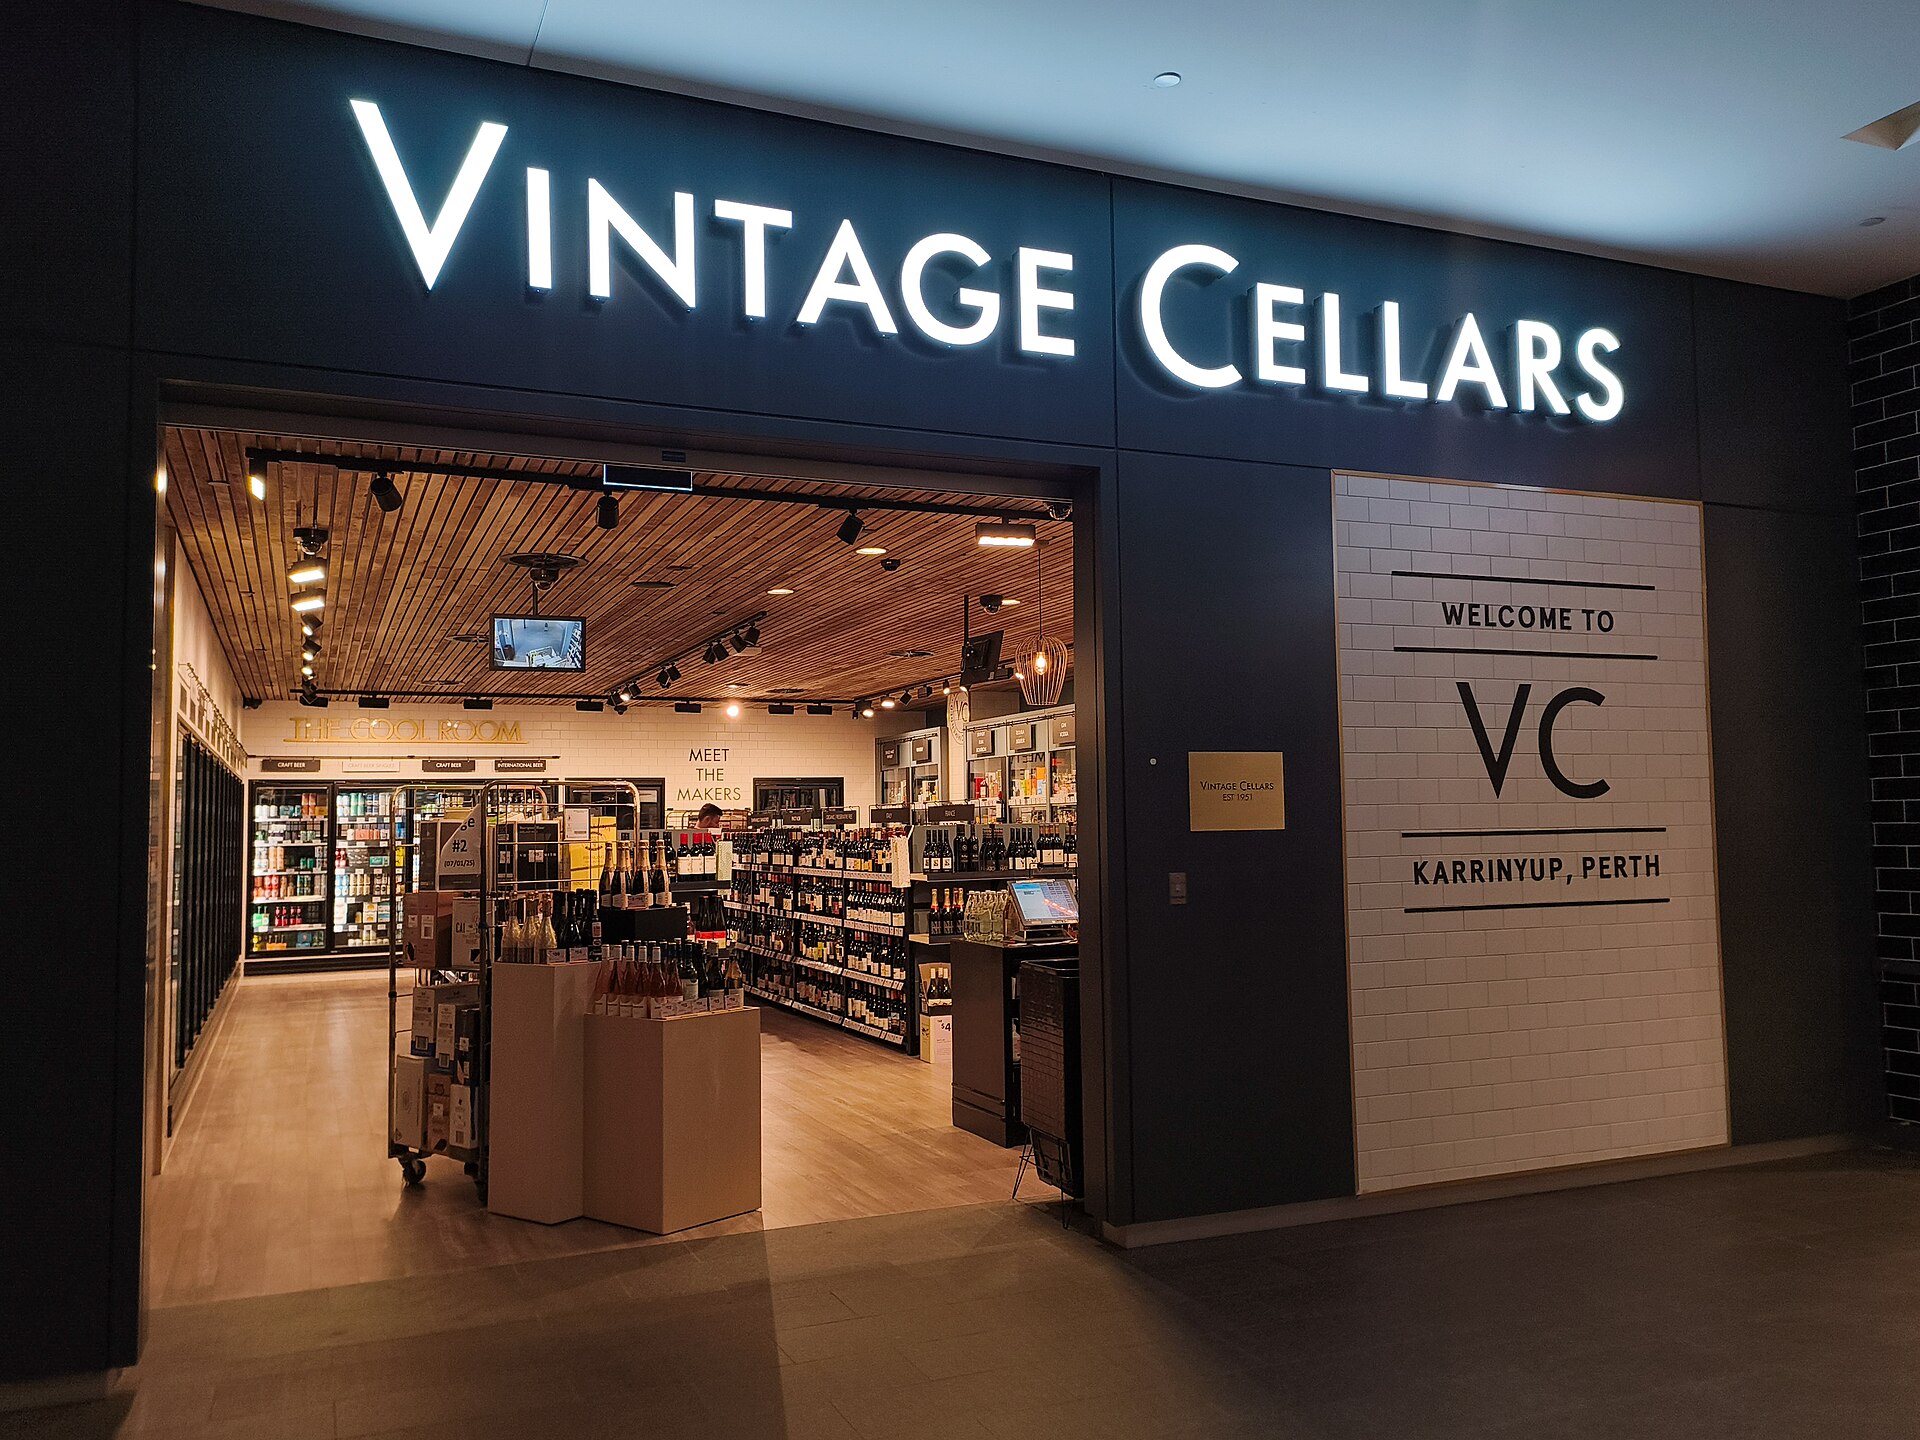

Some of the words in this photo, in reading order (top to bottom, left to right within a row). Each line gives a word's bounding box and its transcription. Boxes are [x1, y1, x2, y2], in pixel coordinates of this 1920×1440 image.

[350, 99, 1076, 357] VINTAGE
[1139, 243, 1625, 422] CELLARS
[1441, 602, 1572, 631] WELCOME
[1581, 609, 1614, 632] TO
[289, 717, 340, 740] THE
[350, 717, 430, 741] COOL
[438, 719, 522, 741] ROOM
[1455, 682, 1611, 799] VC
[689, 748, 730, 762] MEET
[696, 768, 724, 781] THE
[1200, 781, 1237, 791] VINTAGE
[1239, 781, 1275, 791] CELLARS
[677, 787, 741, 801] MAKERS
[1223, 793, 1235, 801] EST
[1237, 793, 1253, 801] 1951
[452, 839, 467, 853] #2
[444, 859, 475, 868] (07/01/25)
[1413, 857, 1573, 885] KARRINYUP,
[1582, 855, 1661, 880] PERTH
